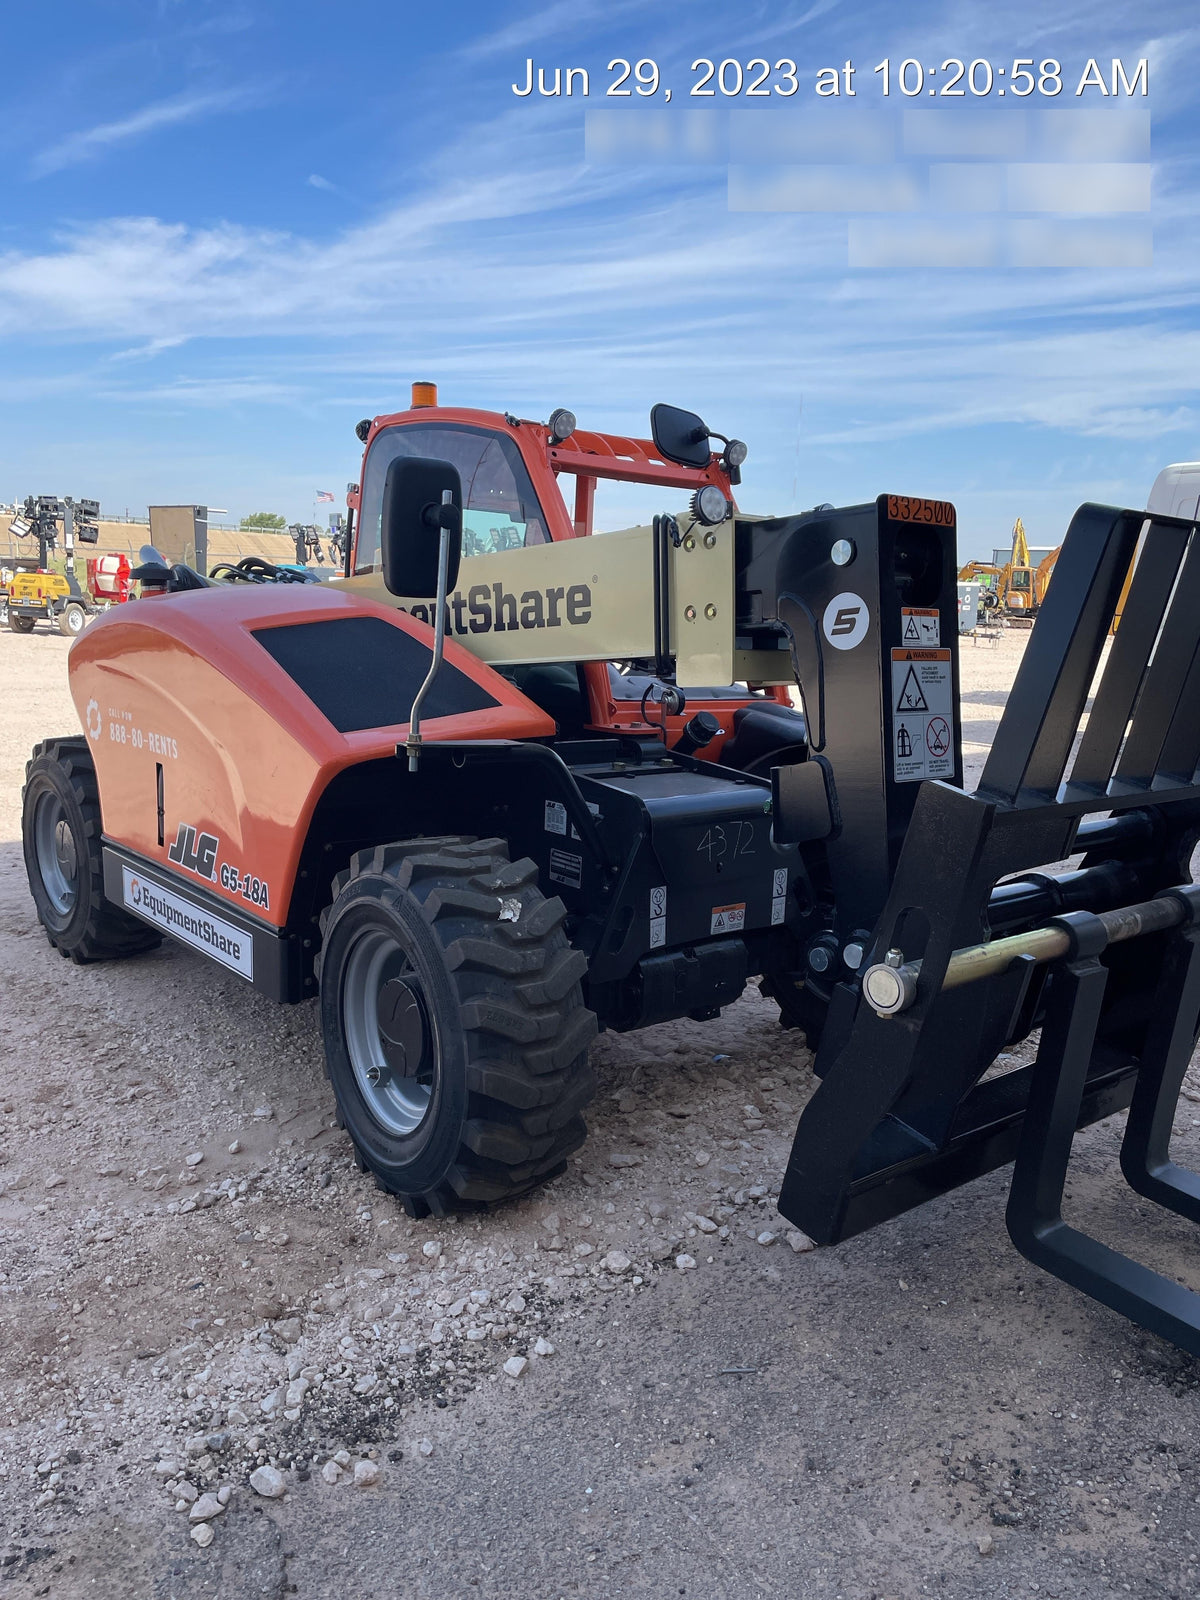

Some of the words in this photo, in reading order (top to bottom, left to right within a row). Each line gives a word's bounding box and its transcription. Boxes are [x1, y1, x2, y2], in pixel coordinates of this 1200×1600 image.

[889, 495, 954, 525] 332500
[913, 651, 938, 659] WARNING
[108, 707, 121, 719] CALL
[109, 722, 178, 759] 888-80-RENTS
[168, 822, 219, 881] JLG
[697, 821, 756, 862] 4372
[220, 862, 270, 911] G5-18A
[142, 886, 240, 961] EquipmentShare
